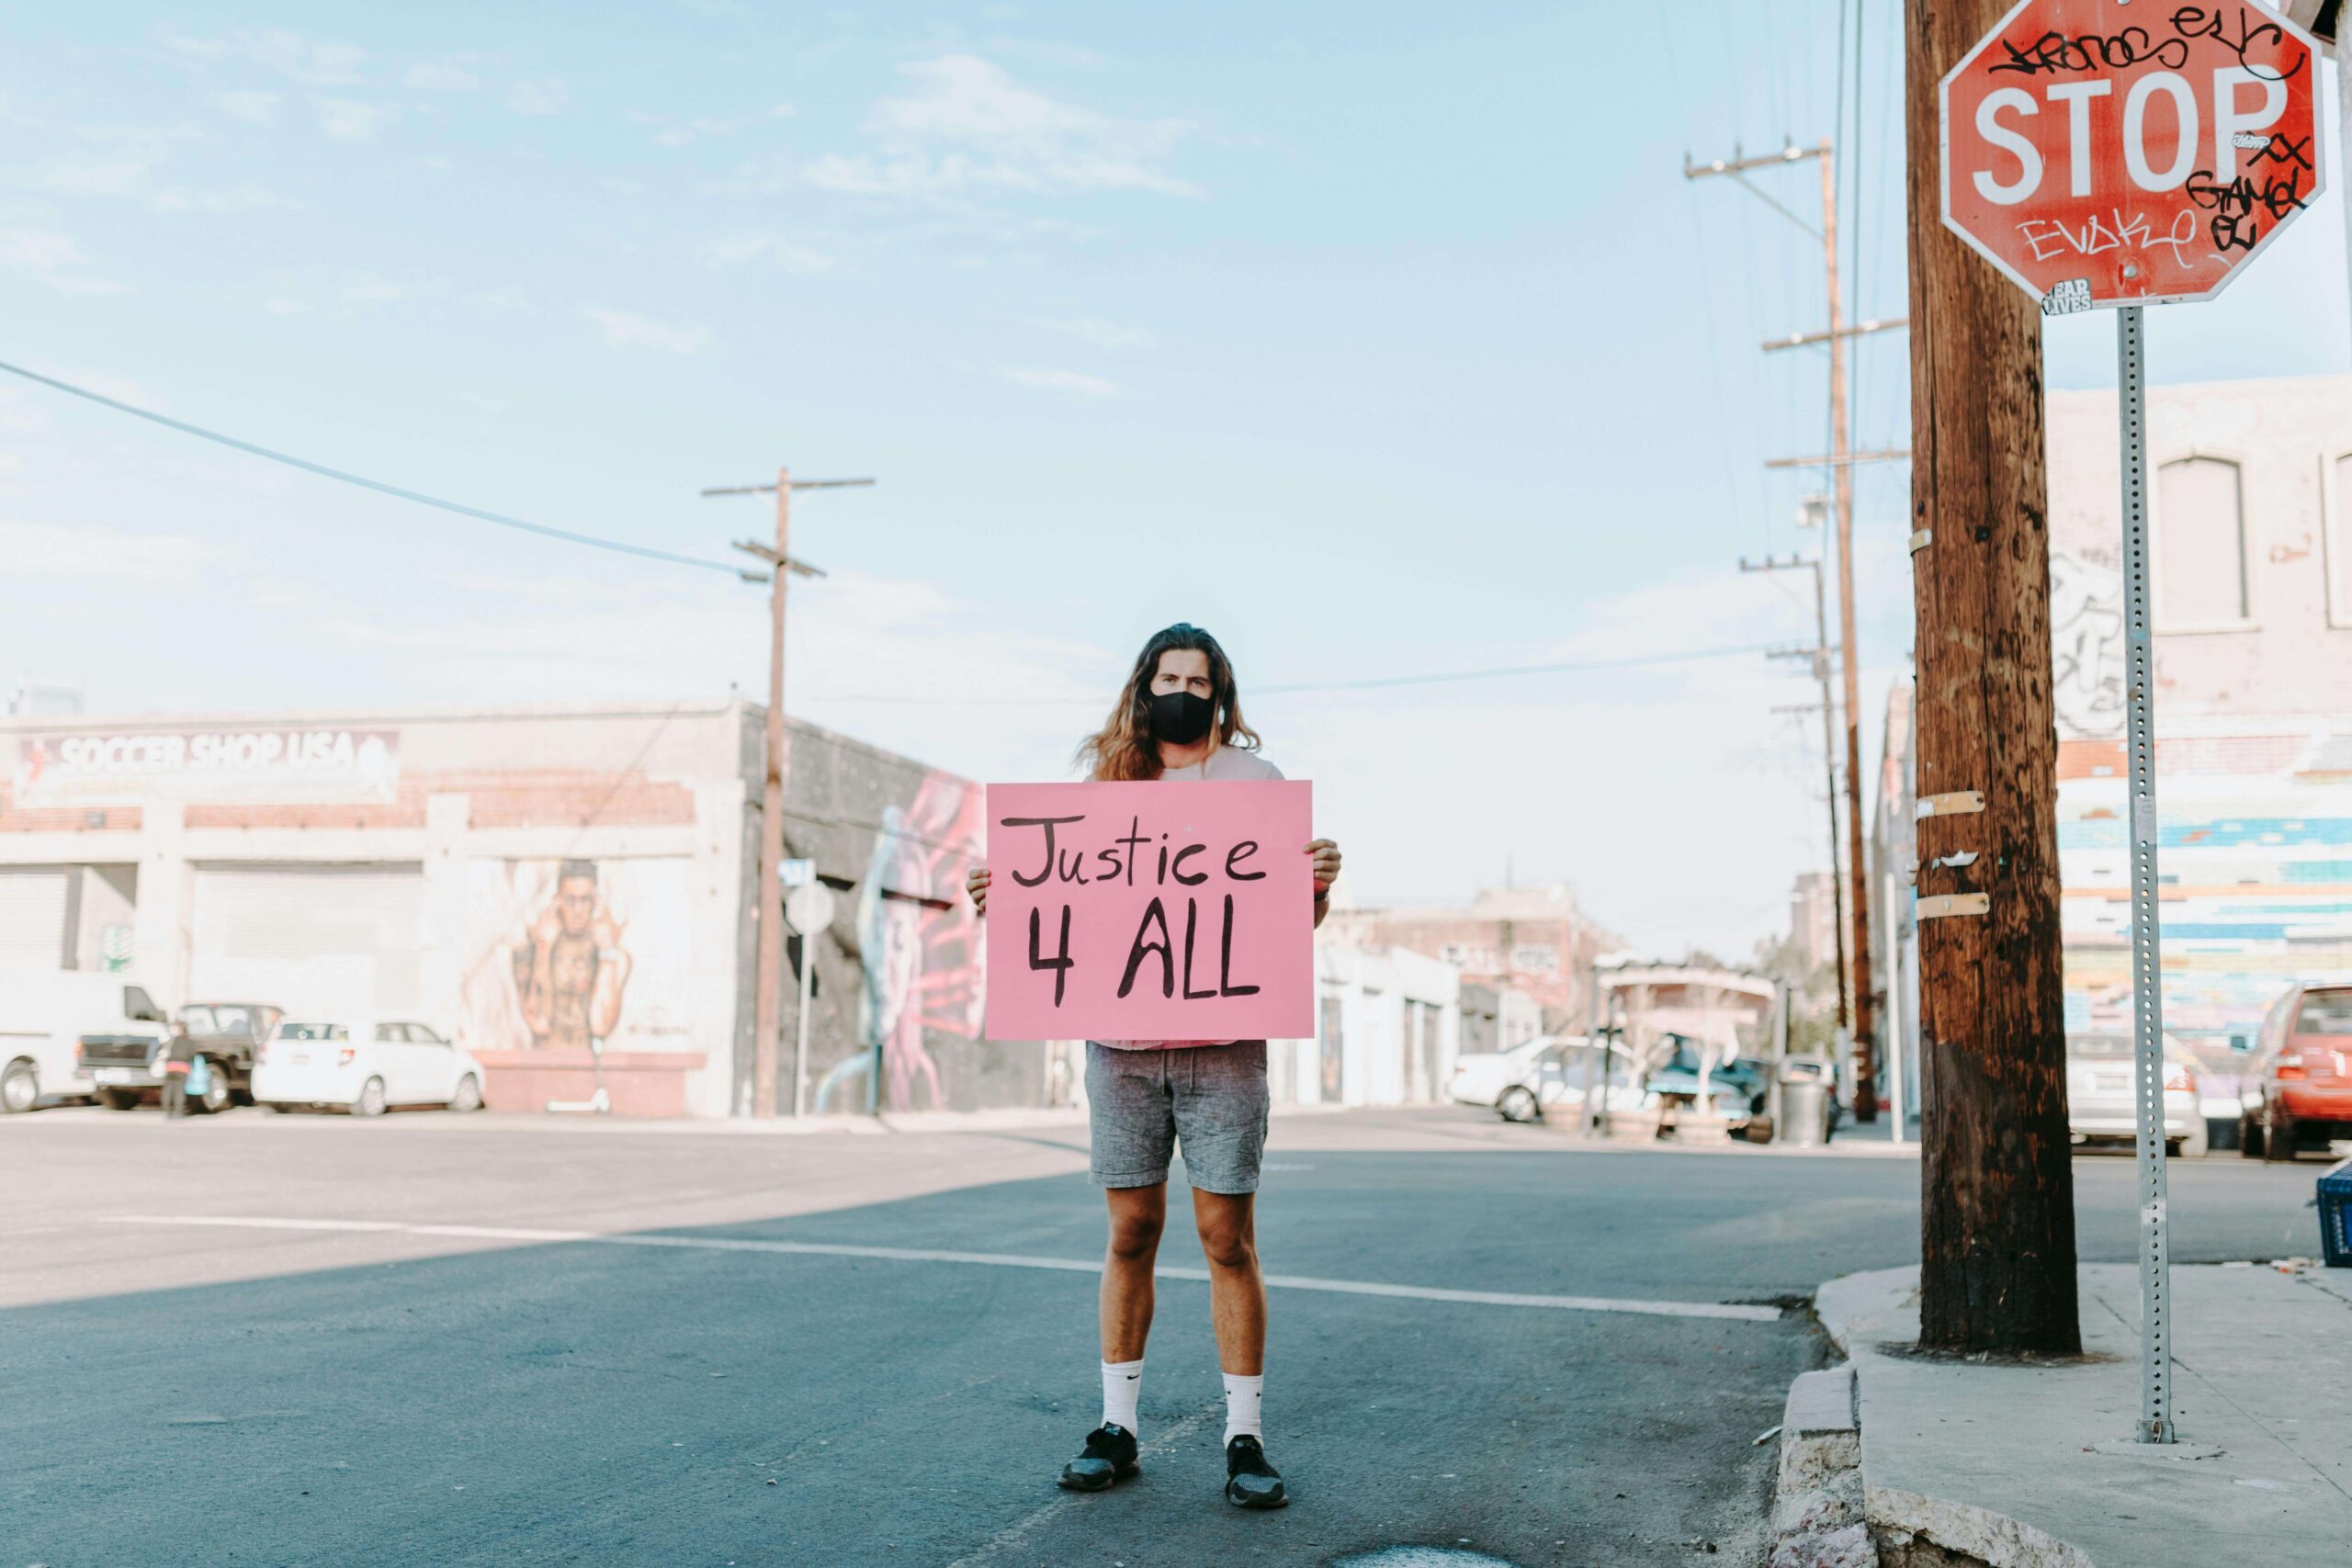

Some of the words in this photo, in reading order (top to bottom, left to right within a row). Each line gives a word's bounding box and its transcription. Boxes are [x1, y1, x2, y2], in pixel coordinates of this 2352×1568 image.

[1973, 64, 2289, 206] STOP
[2043, 297, 2092, 315] LIVES
[60, 735, 186, 775] SOCCER
[189, 733, 282, 772] SHOP
[288, 731, 356, 769] USA
[1001, 815, 1267, 887] Justice
[1028, 904, 1075, 1009] 4
[1116, 893, 1261, 1000] ALL
